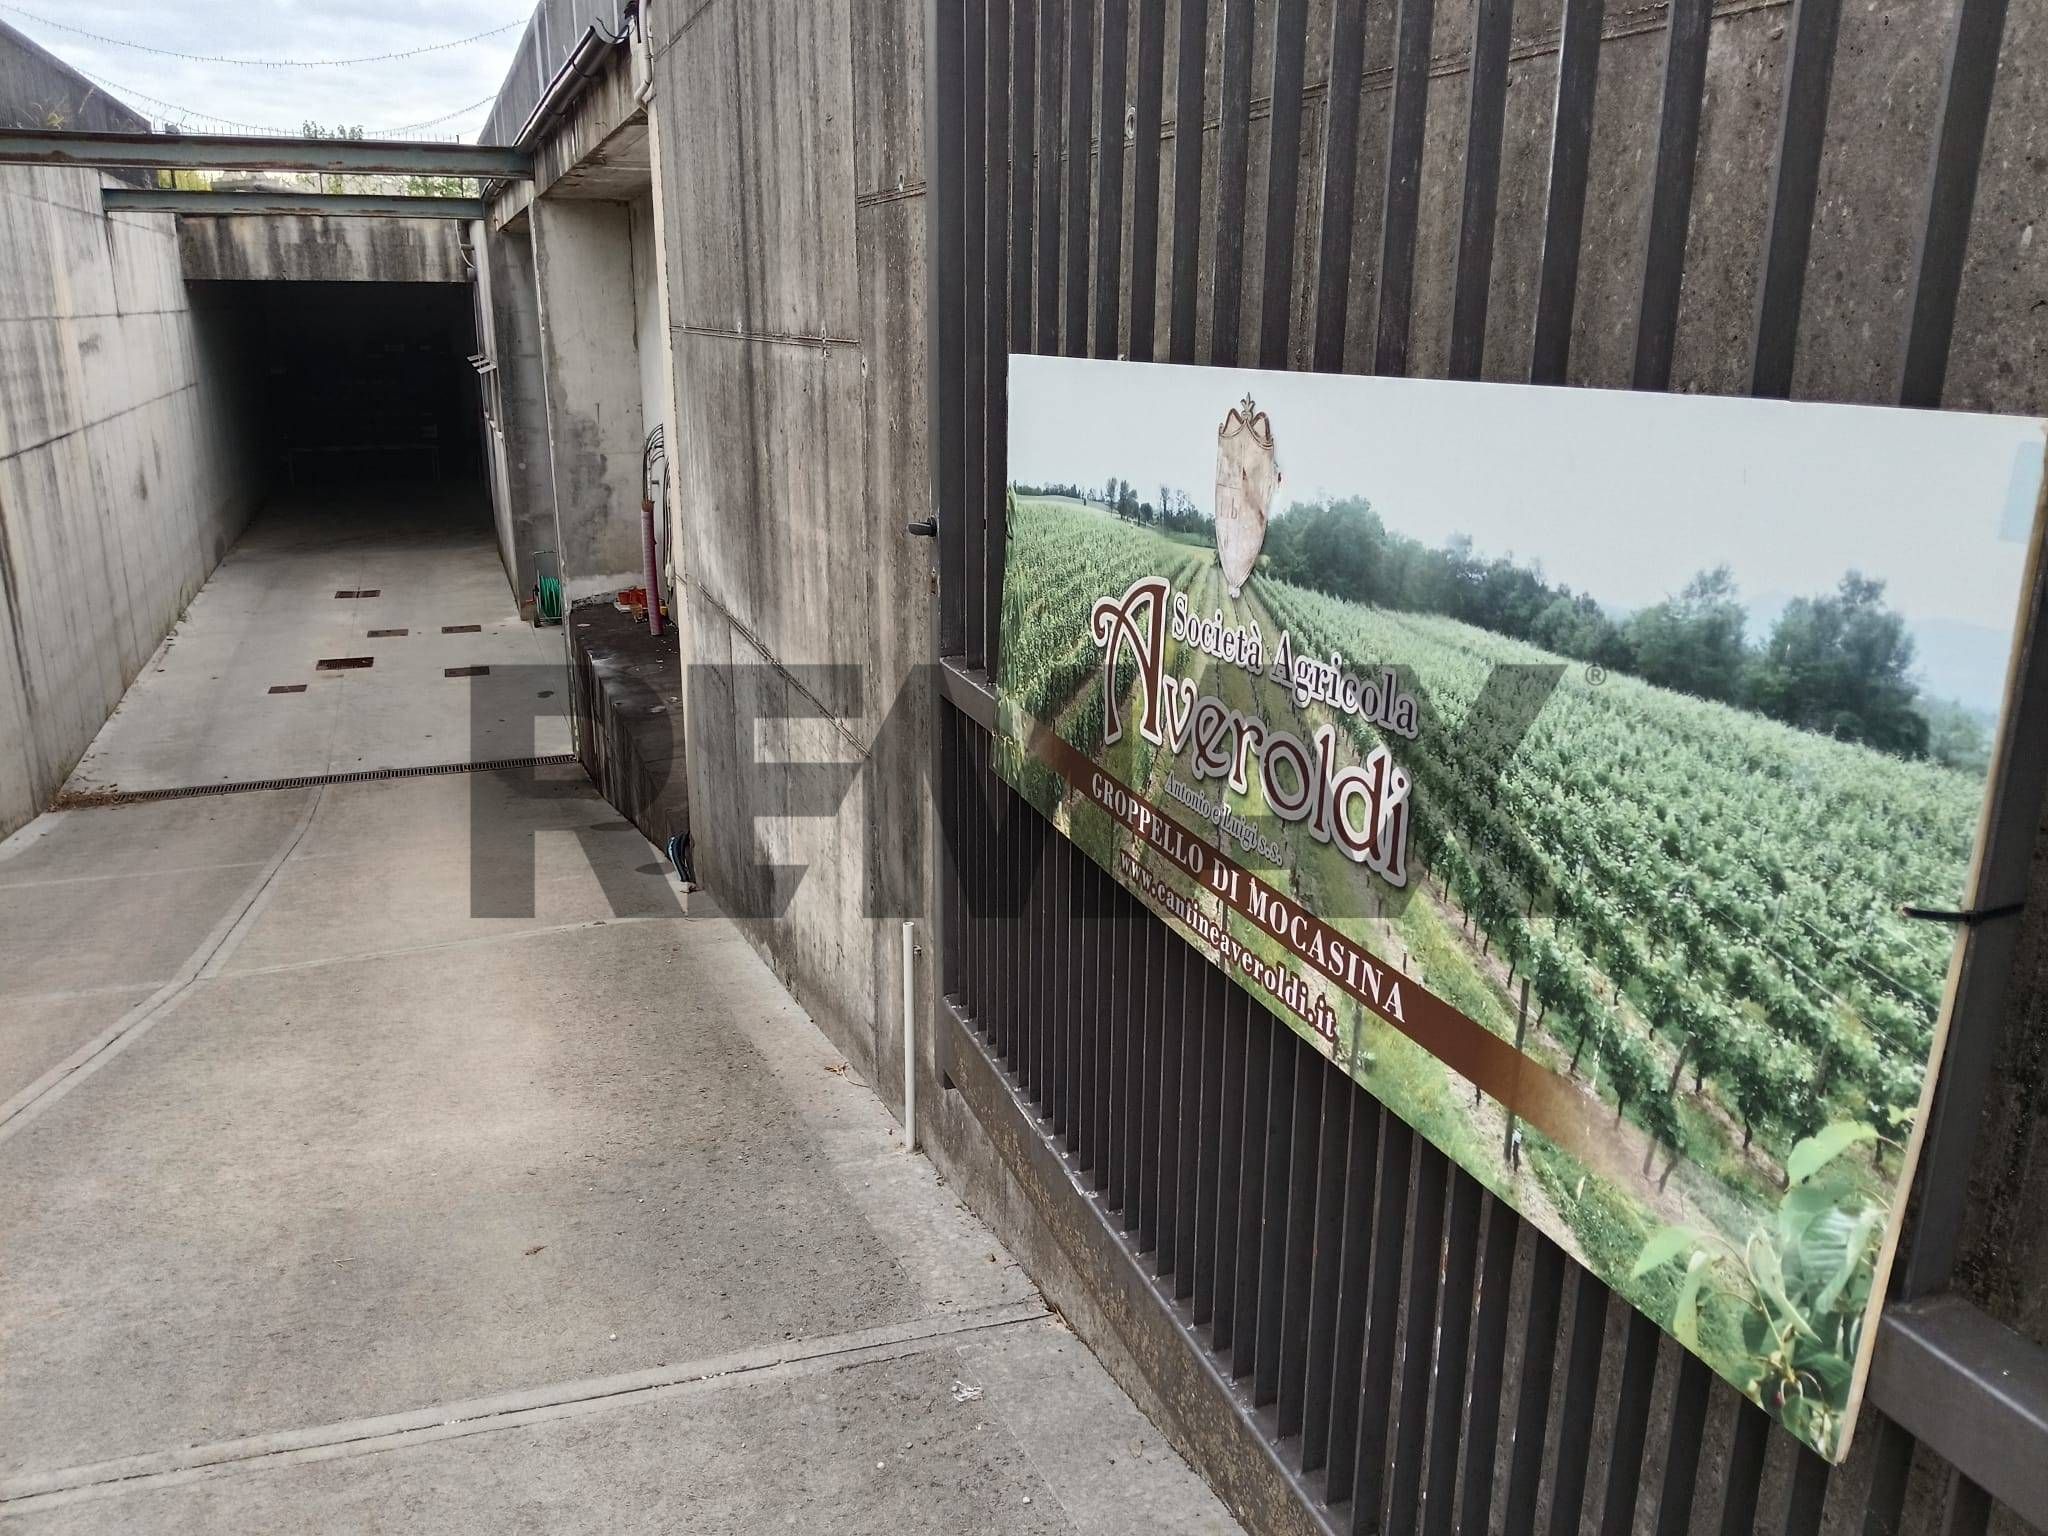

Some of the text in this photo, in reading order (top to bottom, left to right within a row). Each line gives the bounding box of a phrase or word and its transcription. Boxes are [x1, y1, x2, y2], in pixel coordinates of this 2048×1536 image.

[1092, 577, 1411, 886] Averoldi
[1172, 592, 1418, 738] Società Agricola
[1091, 772, 1407, 1024] GROPPELLO DI MOCASINA
[1165, 770, 1211, 819] Antonio
[1221, 802, 1258, 851] Luigi
[1119, 851, 1337, 1038] www.cantineaveroldi.it
